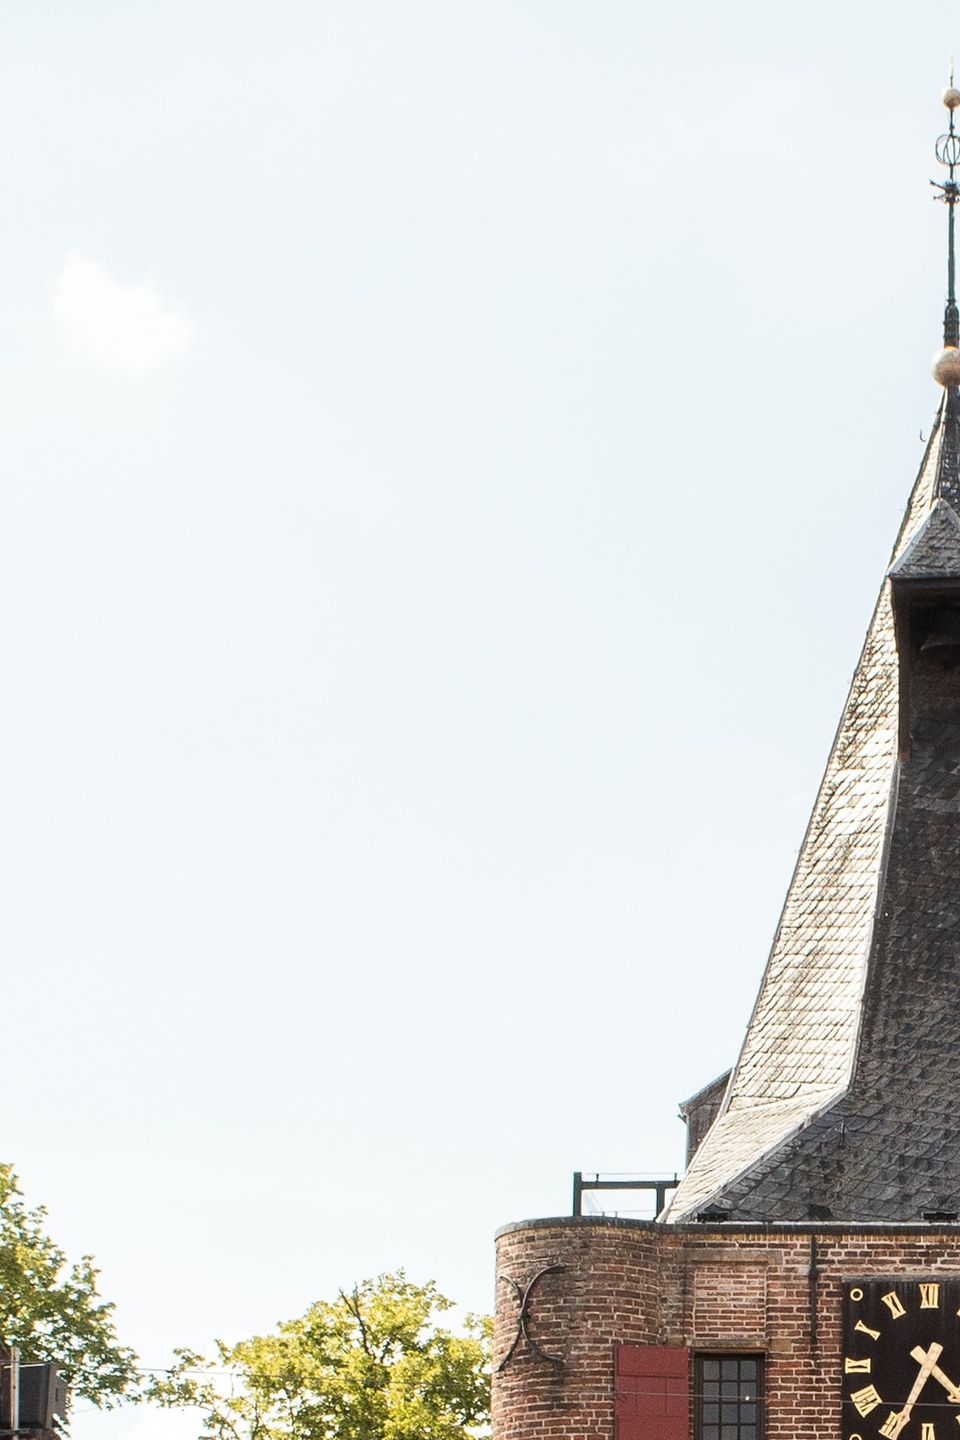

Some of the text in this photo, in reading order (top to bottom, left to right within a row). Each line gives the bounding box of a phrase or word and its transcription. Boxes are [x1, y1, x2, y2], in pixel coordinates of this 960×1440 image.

[881, 1291, 906, 1320] XI
[919, 1283, 940, 1309] XII
[854, 1320, 881, 1341] X
